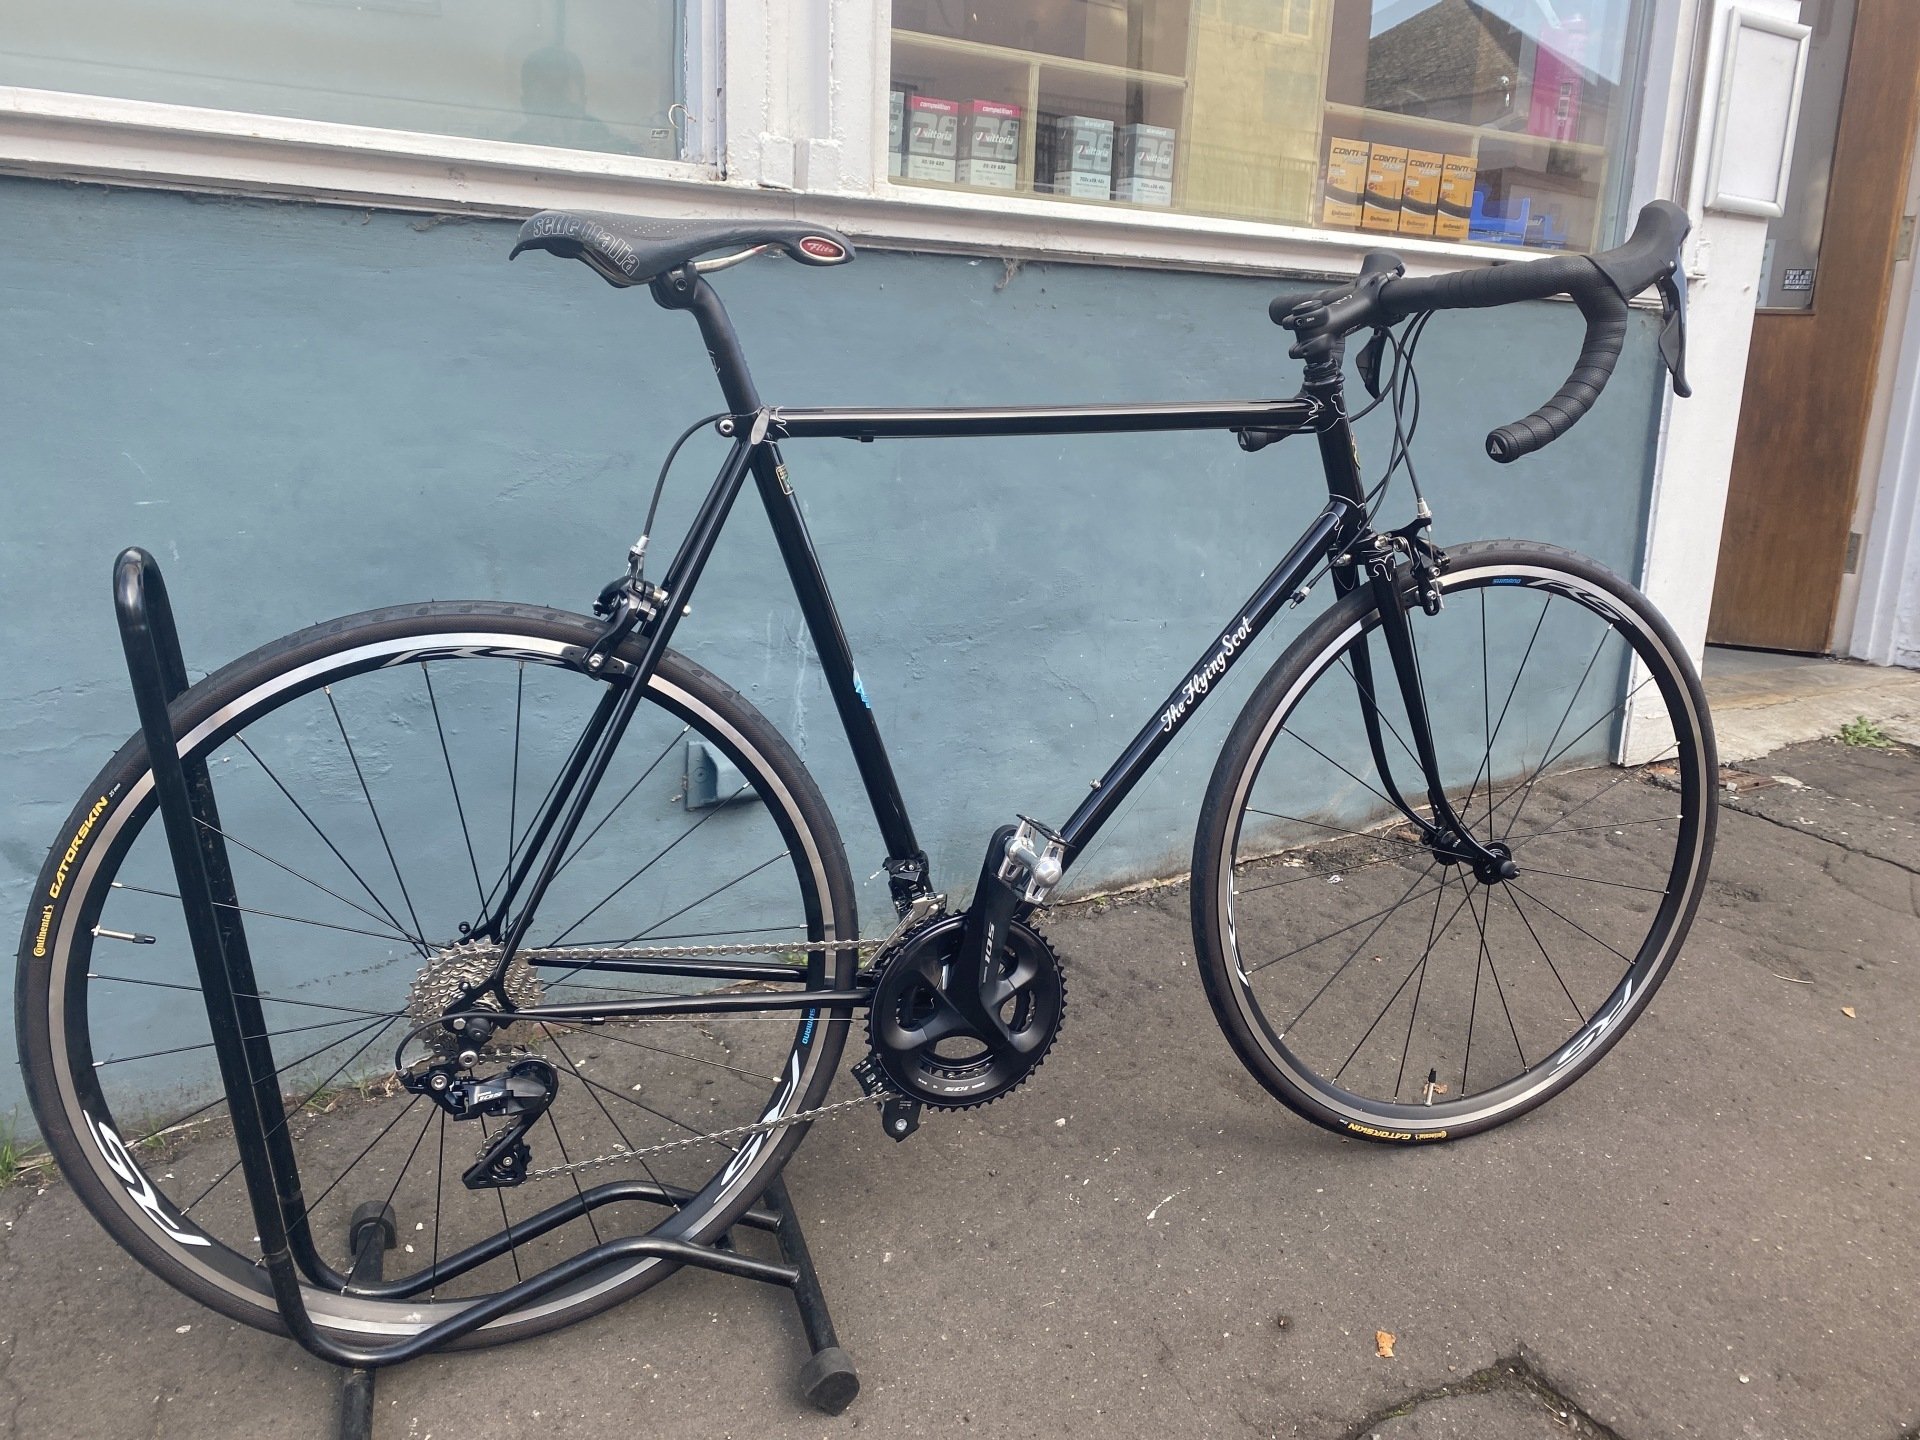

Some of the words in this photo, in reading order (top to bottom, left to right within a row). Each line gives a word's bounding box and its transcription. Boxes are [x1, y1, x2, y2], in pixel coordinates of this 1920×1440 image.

[1332, 147, 1360, 157] CONTI
[1372, 154, 1399, 163] CONTI
[1409, 160, 1434, 169] CONTI
[1445, 164, 1469, 172] CONTI
[533, 215, 581, 238] selle
[1160, 704, 1186, 733] The
[1182, 652, 1227, 705] Flying
[1221, 615, 1253, 657] Scot
[49, 795, 109, 899] GATORSKIN
[1348, 1123, 1412, 1140] GATORSKIN
